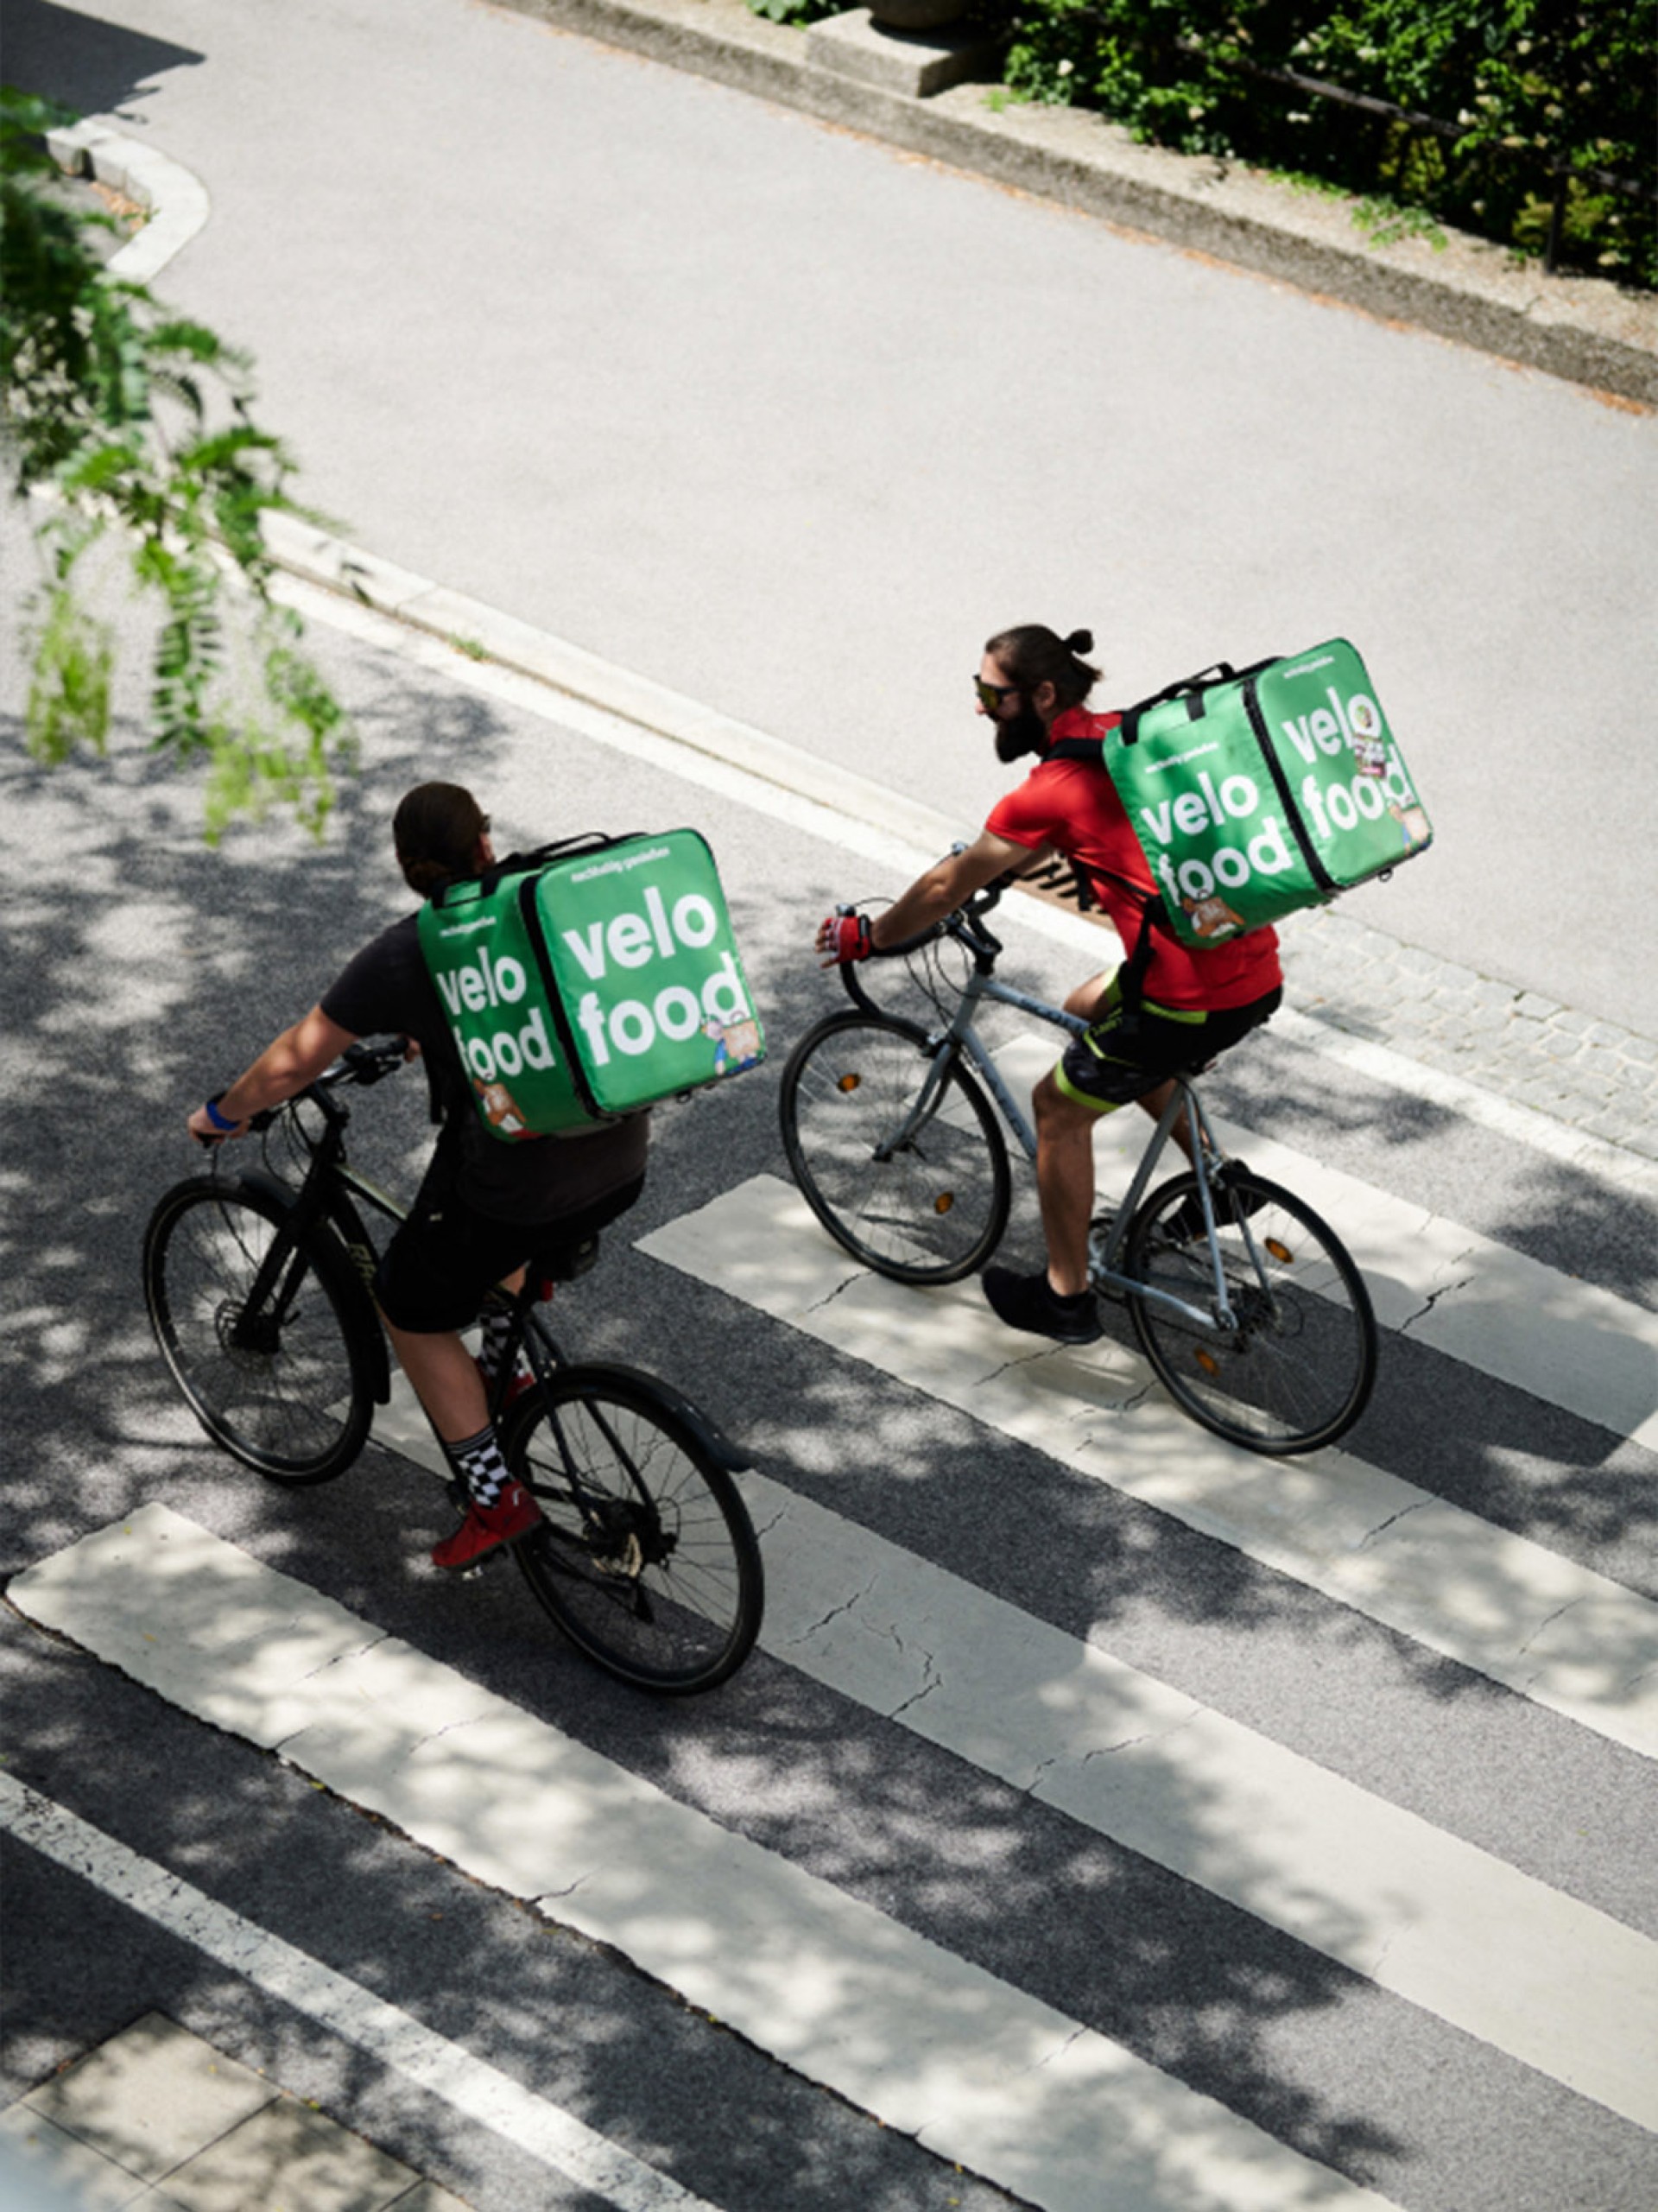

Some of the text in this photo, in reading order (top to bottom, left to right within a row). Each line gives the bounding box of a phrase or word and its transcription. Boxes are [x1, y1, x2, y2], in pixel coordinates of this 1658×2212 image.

[1281, 688, 1382, 764] velo
[1140, 773, 1260, 846] velo
[1301, 745, 1415, 839] food
[1159, 816, 1294, 907] food
[562, 885, 718, 981] velo
[436, 947, 527, 1016] velo
[578, 952, 751, 1067] food
